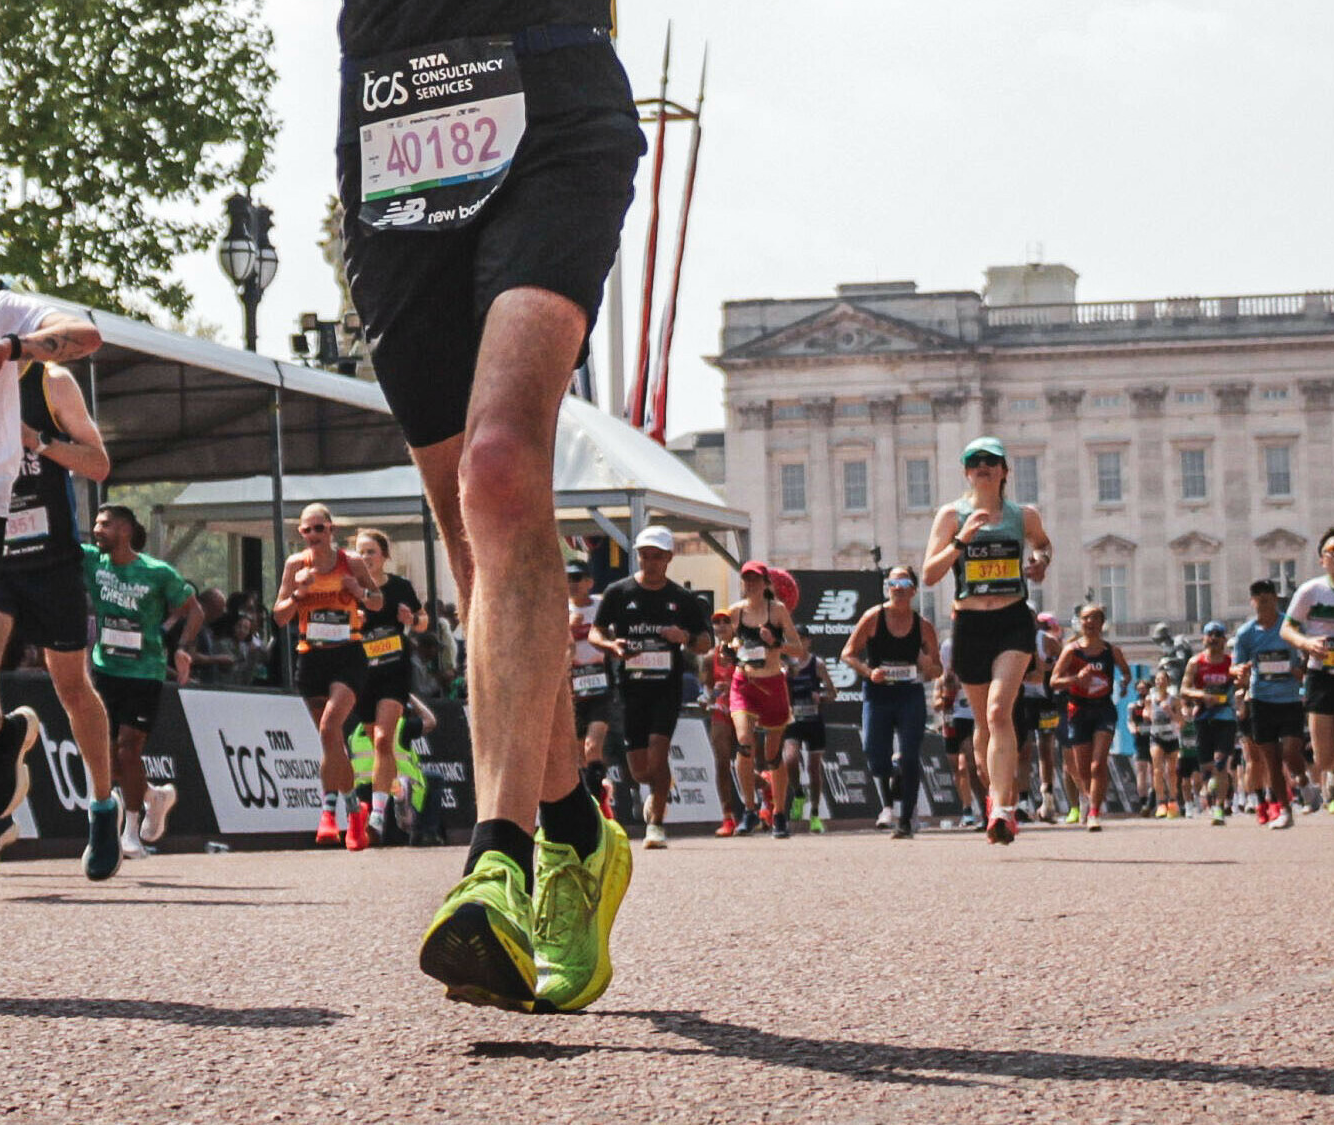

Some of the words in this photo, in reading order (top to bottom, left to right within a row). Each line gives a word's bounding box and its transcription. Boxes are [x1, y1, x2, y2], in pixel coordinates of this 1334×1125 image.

[409, 52, 449, 71] TATA
[411, 58, 504, 86] CONSULTANCY
[363, 70, 409, 112] tcs
[415, 78, 474, 101] SERVICES
[386, 116, 501, 177] 40182
[427, 208, 456, 225] new
[264, 729, 295, 752] TATA
[218, 728, 280, 809] tcs
[281, 787, 322, 809] SERVICES
